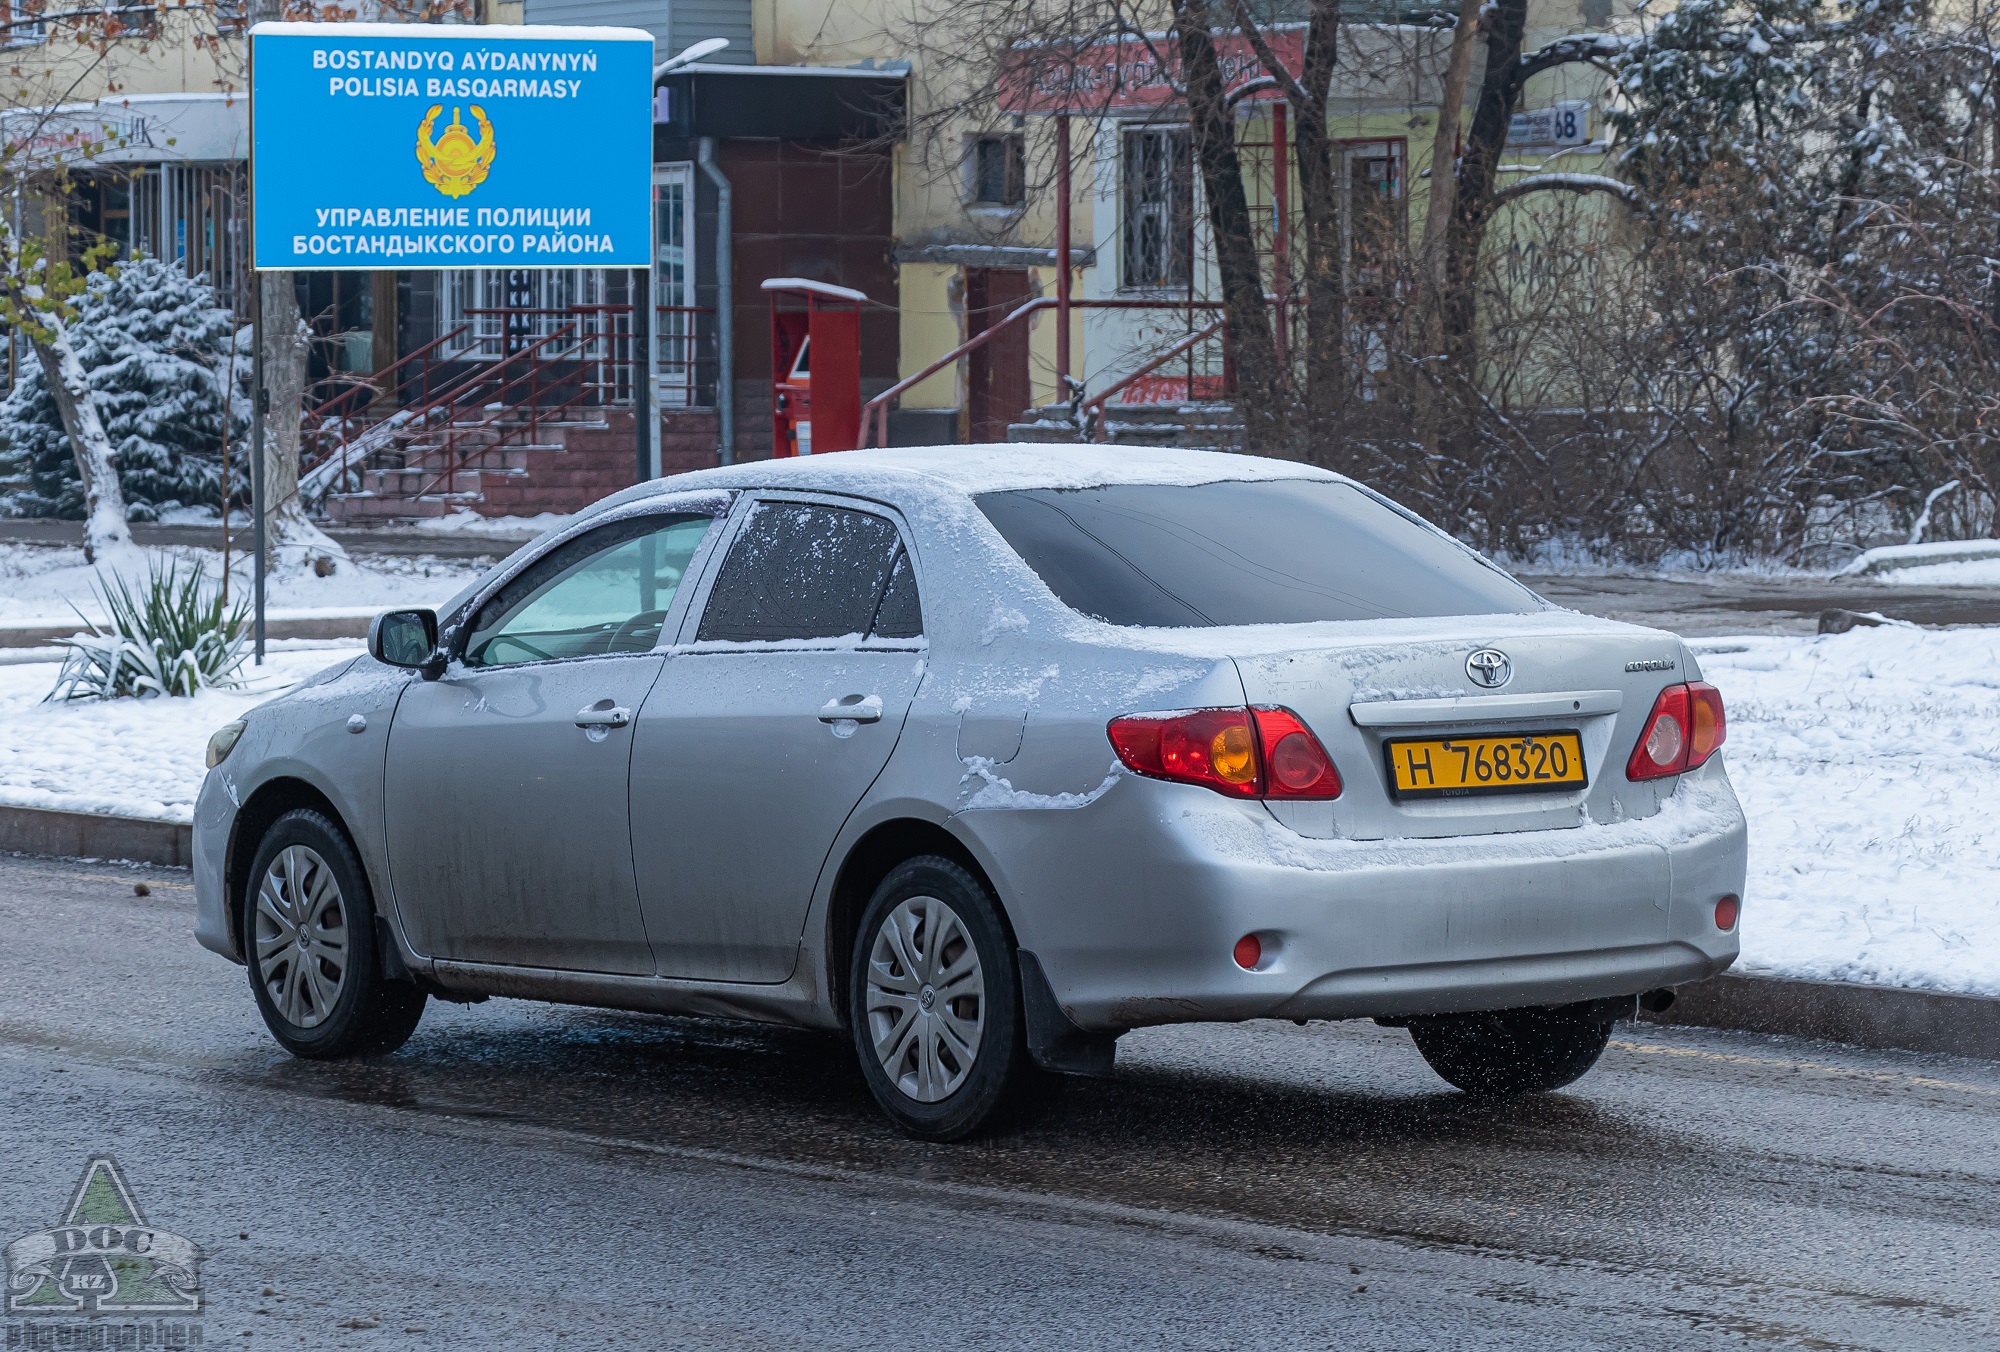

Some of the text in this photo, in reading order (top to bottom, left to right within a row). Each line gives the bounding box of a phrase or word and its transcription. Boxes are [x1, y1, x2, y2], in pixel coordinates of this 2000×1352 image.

[312, 47, 598, 73] BOSTANDYQ AÝDANYNYŃ
[328, 76, 582, 98] POLISIA BASQARMASY
[1555, 110, 1577, 139] 68
[315, 207, 592, 230] УПРАВЛЕНИЕ ПОЛИЦИИ
[292, 231, 615, 257] БОСТАНДЫКСКОГО РАЙОНА
[1406, 741, 1568, 786] H 768320
[1441, 789, 1470, 797] TOYOTA
